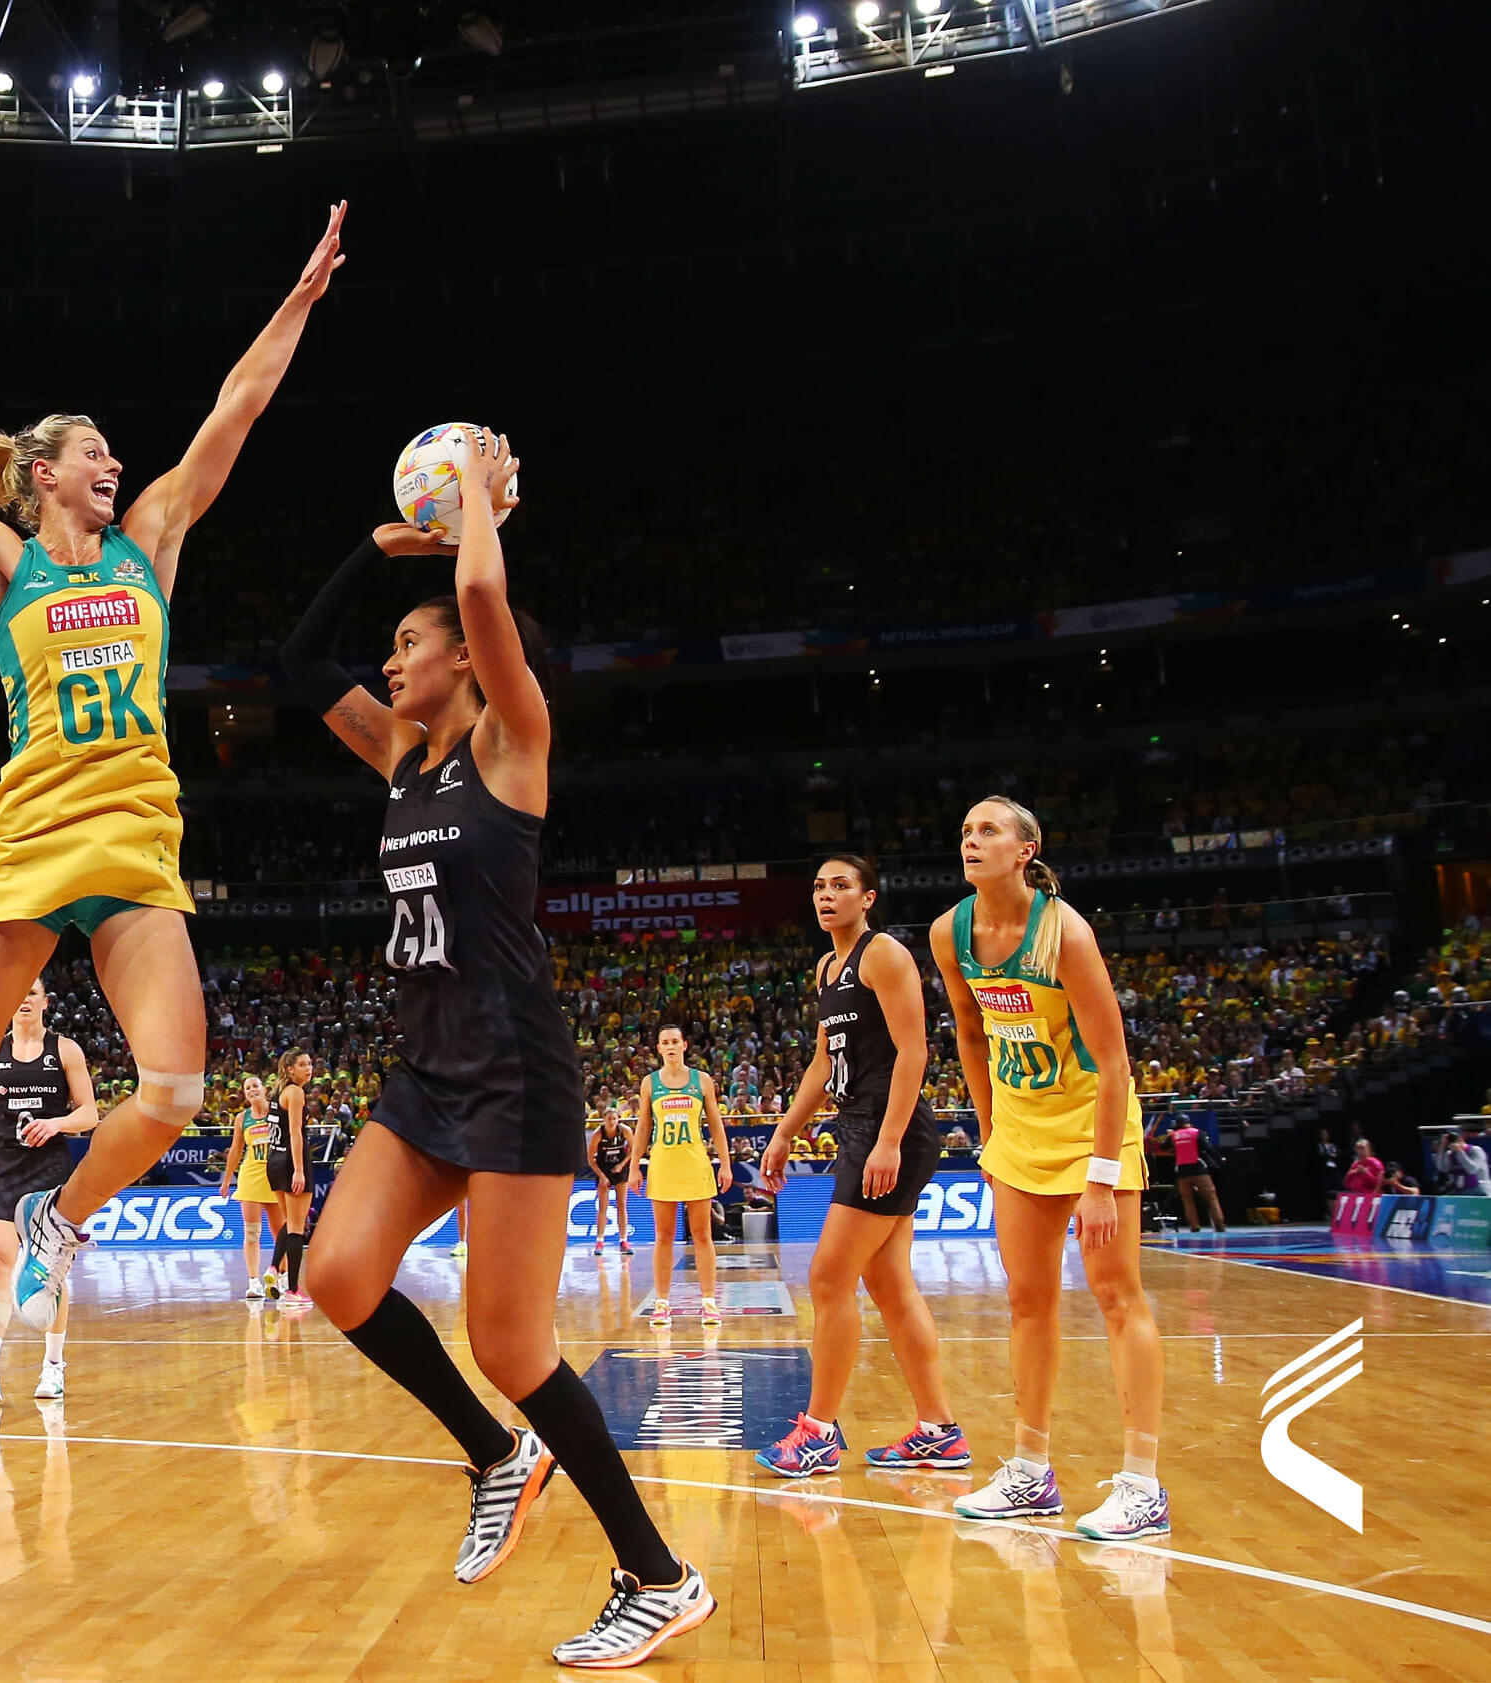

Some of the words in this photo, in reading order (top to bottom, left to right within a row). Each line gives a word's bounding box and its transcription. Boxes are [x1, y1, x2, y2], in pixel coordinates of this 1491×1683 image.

[68, 572, 101, 583] BLK
[51, 599, 135, 622] CHEMIST
[53, 616, 137, 632] WAREHOUSE
[63, 643, 134, 669] TELSTRA
[57, 663, 157, 745] GK
[385, 836, 408, 852] NEW
[409, 826, 461, 846] WORLD
[387, 866, 434, 888] TELSTRA
[546, 890, 741, 917] allphones
[385, 894, 458, 970] GA
[976, 990, 1030, 1007] CHEMIST
[998, 1038, 1059, 1090] WD
[29, 1086, 58, 1094] WORLD
[663, 1121, 692, 1146] GA
